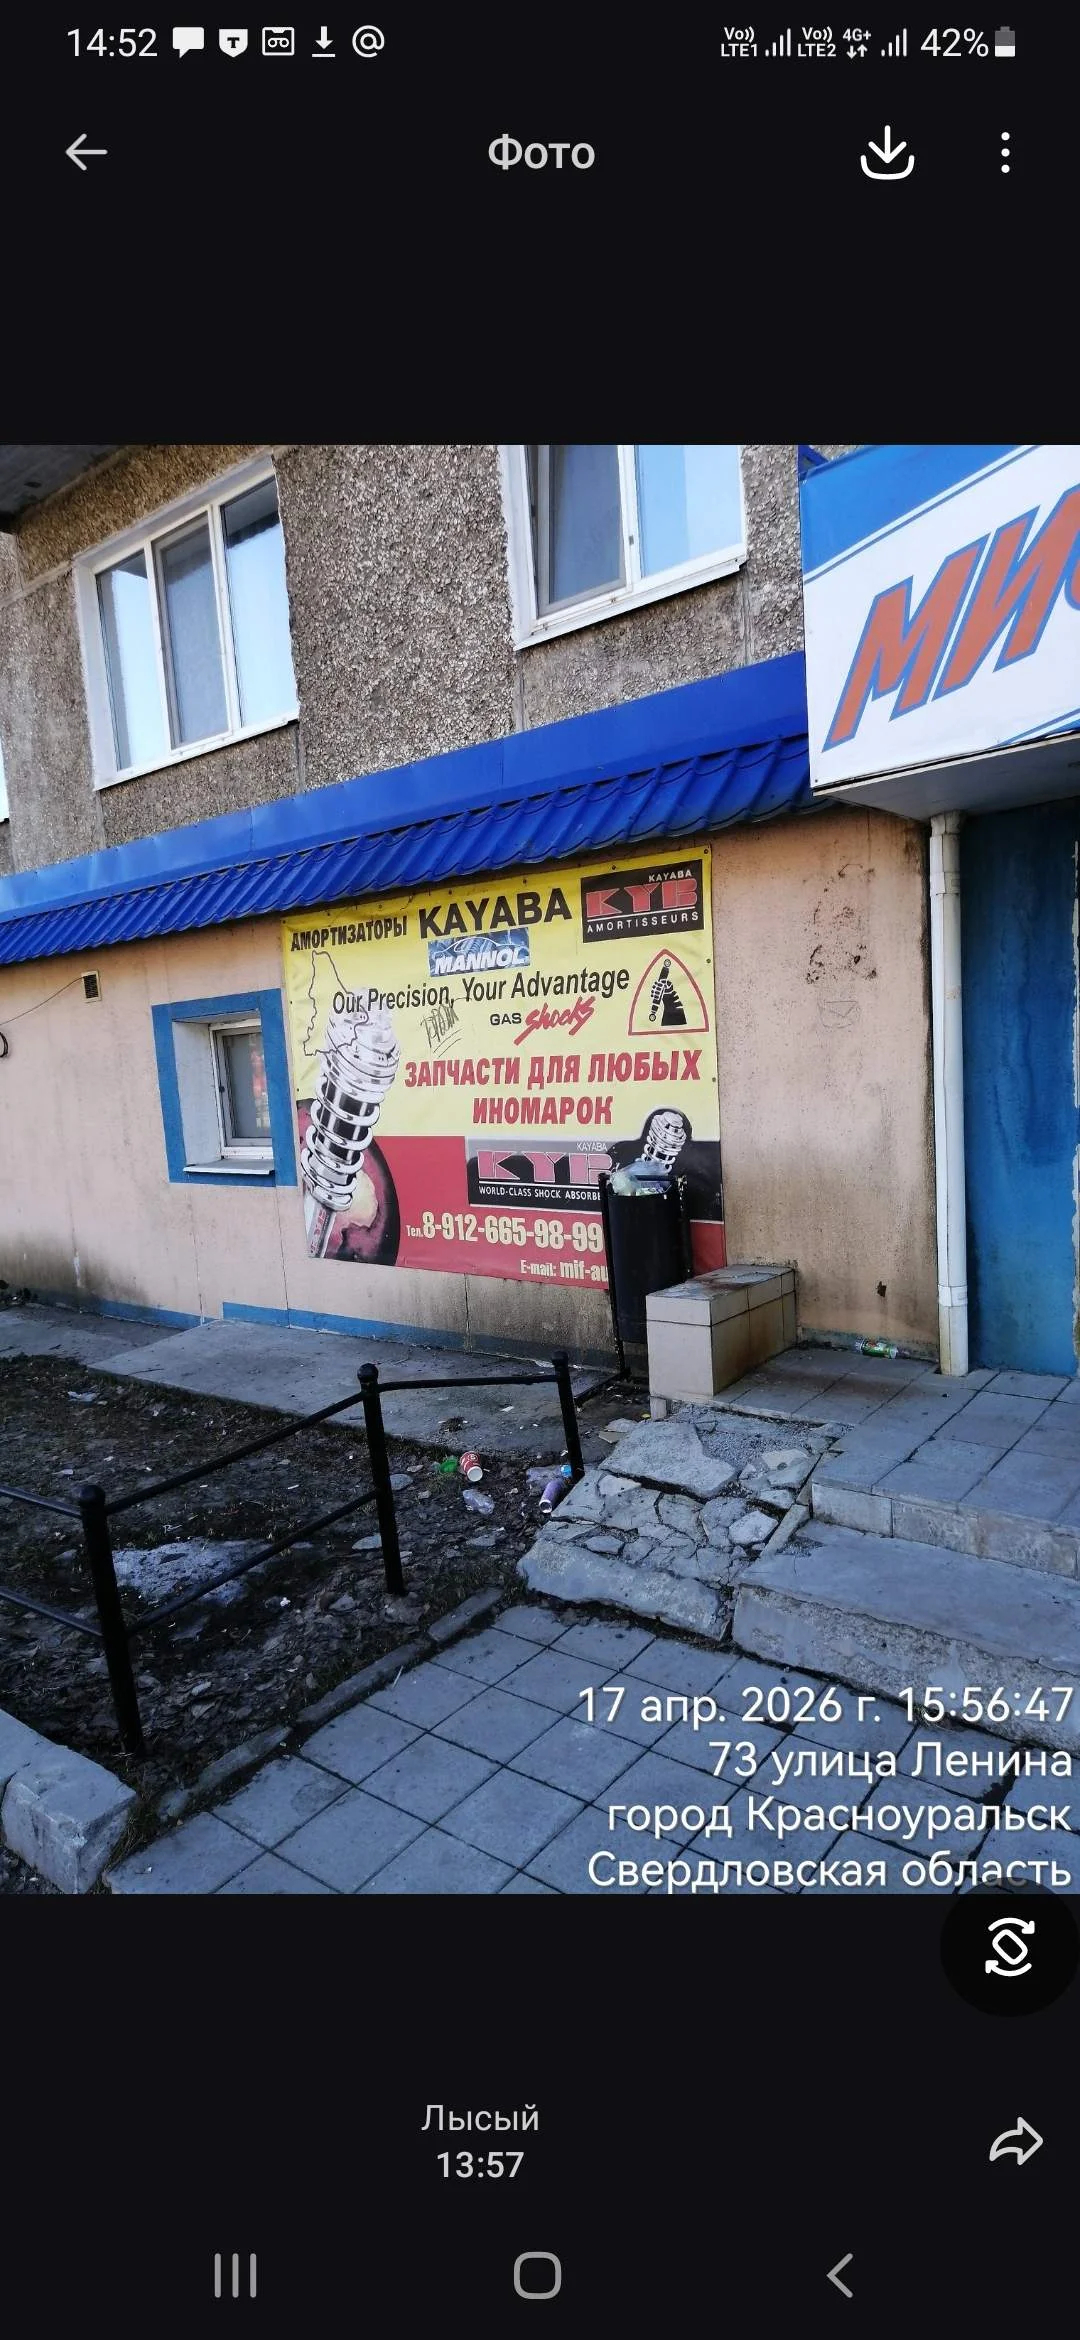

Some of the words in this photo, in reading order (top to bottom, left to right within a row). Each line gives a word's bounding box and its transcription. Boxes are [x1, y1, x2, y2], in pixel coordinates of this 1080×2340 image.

[821, 482, 1080, 753] МИ
[649, 868, 692, 883] KAYABA
[585, 877, 698, 918] KYB
[290, 914, 408, 952] АМОРТИЗАТОРЫ
[418, 886, 572, 940] KAYABA
[586, 910, 699, 934] AMORTISSEURS
[433, 945, 528, 976] MANNOL
[332, 989, 363, 1015] Our
[367, 983, 455, 1008] Precision,
[461, 976, 507, 1004] Your
[510, 967, 630, 999] Advantage
[489, 1012, 522, 1027] GAS
[404, 1057, 521, 1088] ЗАПЧАСТИ
[526, 1054, 582, 1090] ДЛЯ
[587, 1049, 703, 1083] ЛЮБЫХ
[472, 1095, 614, 1125] ИНОМАРОК
[576, 1142, 608, 1152] KAYABA
[478, 1186, 532, 1198] WORLD-CLASS
[534, 1189, 561, 1199] SHOCK
